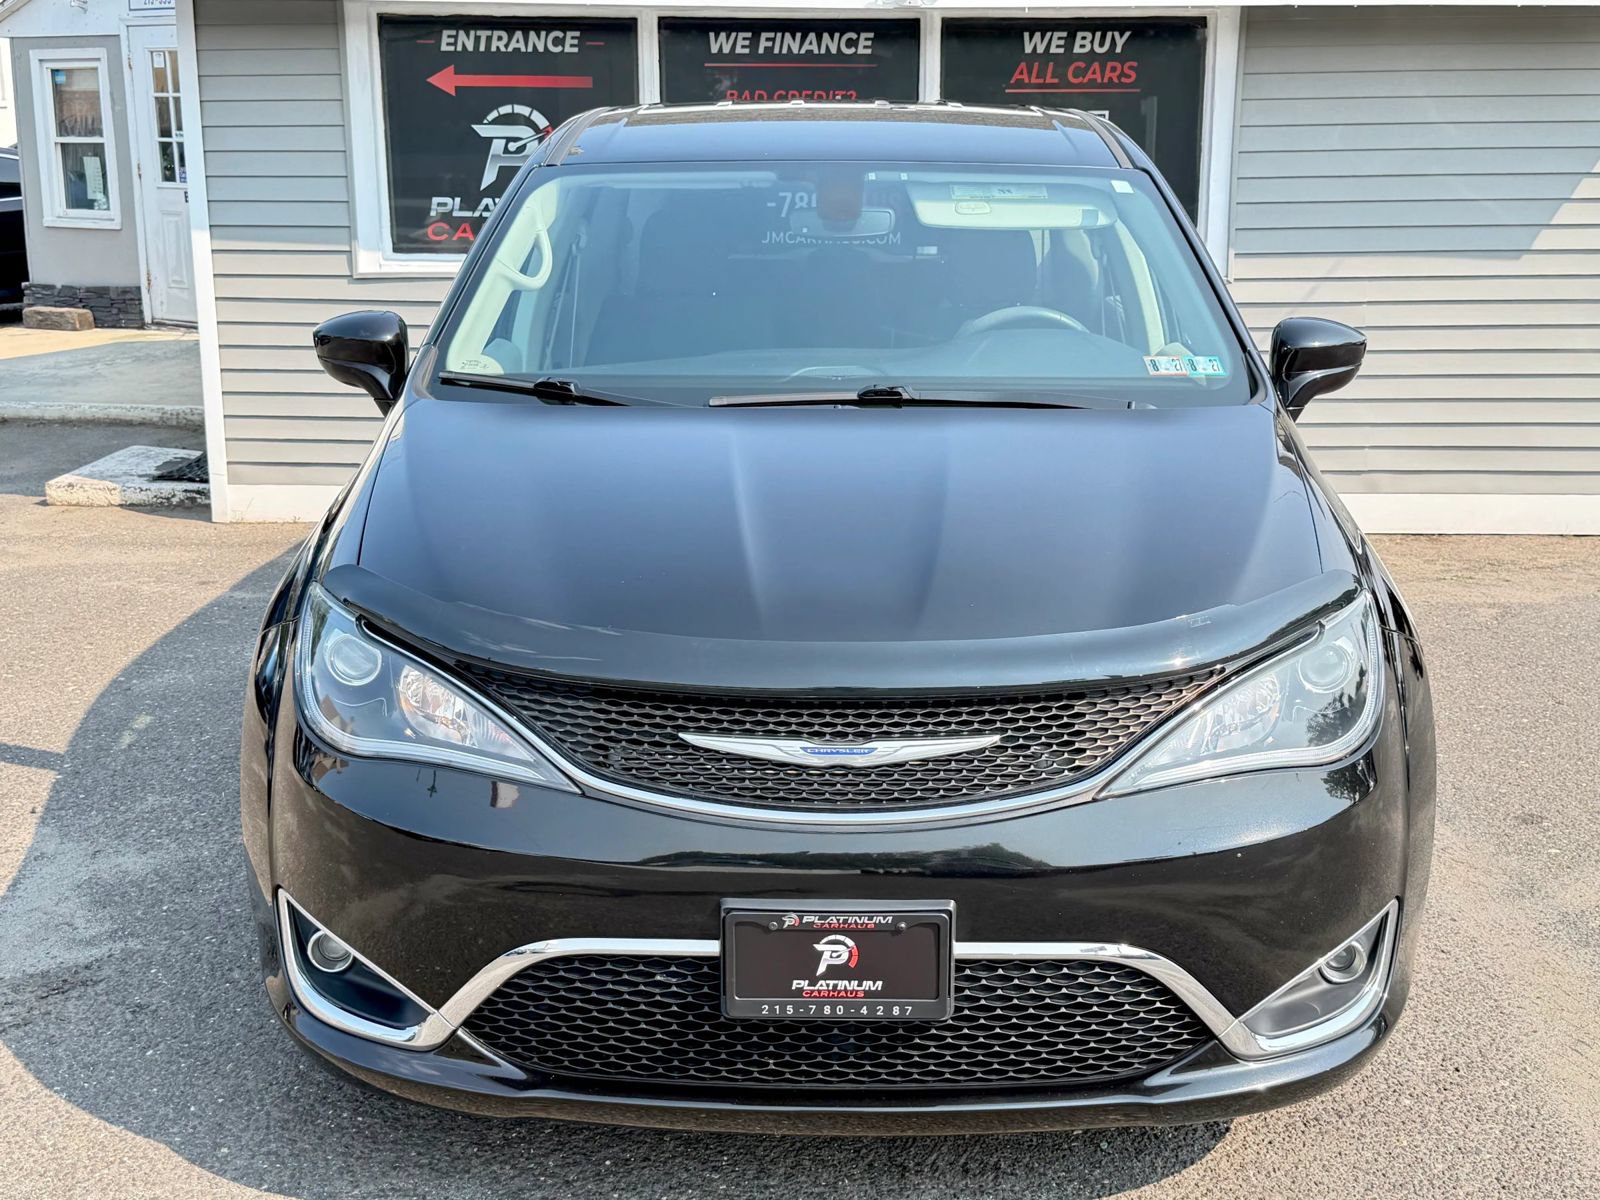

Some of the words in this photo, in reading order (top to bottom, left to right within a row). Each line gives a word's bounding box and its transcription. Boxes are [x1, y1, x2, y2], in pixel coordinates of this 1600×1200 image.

[440, 30, 580, 52] ENTRANCE
[709, 32, 752, 54] WE
[758, 32, 875, 55] FINANCE
[1023, 31, 1068, 54] WE
[1073, 31, 1132, 54] BUY
[1010, 62, 1059, 84] ALL
[1067, 62, 1137, 83] CARS
[726, 90, 768, 101] BAD
[430, 196, 501, 217] PLA
[427, 222, 475, 241] CA
[802, 915, 893, 924] PLATINUM
[791, 979, 883, 991] PLATINUM
[802, 990, 865, 998] CARHAUS
[761, 1004, 913, 1016] 215-780-4287
